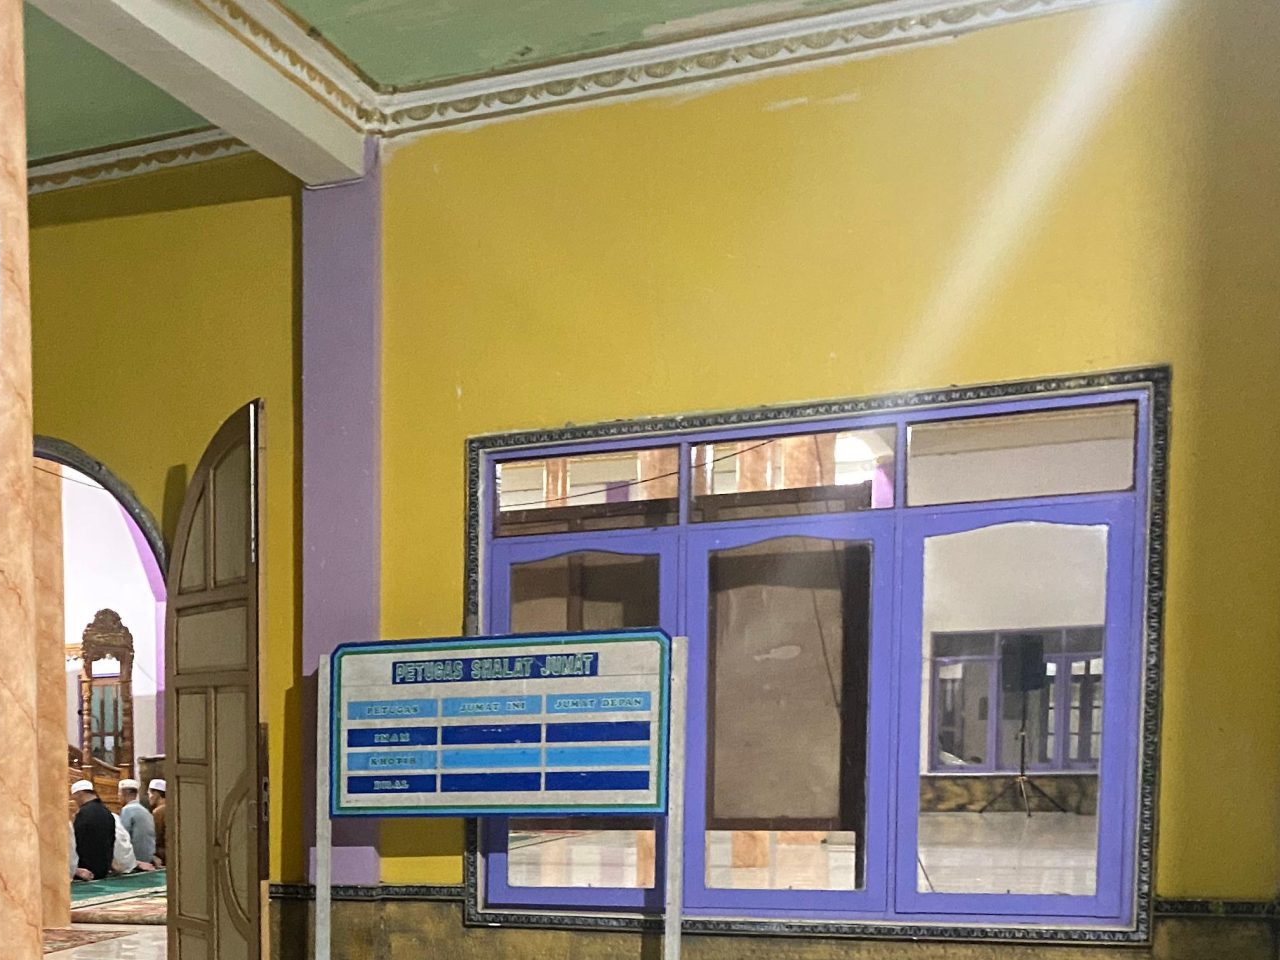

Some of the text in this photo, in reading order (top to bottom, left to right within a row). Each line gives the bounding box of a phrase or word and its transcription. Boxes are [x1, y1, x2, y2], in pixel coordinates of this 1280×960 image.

[395, 654, 594, 683] PETUGAS SHALAT JUMAT
[459, 701, 526, 713] JUMAT INI
[554, 699, 596, 710] JUMAT
